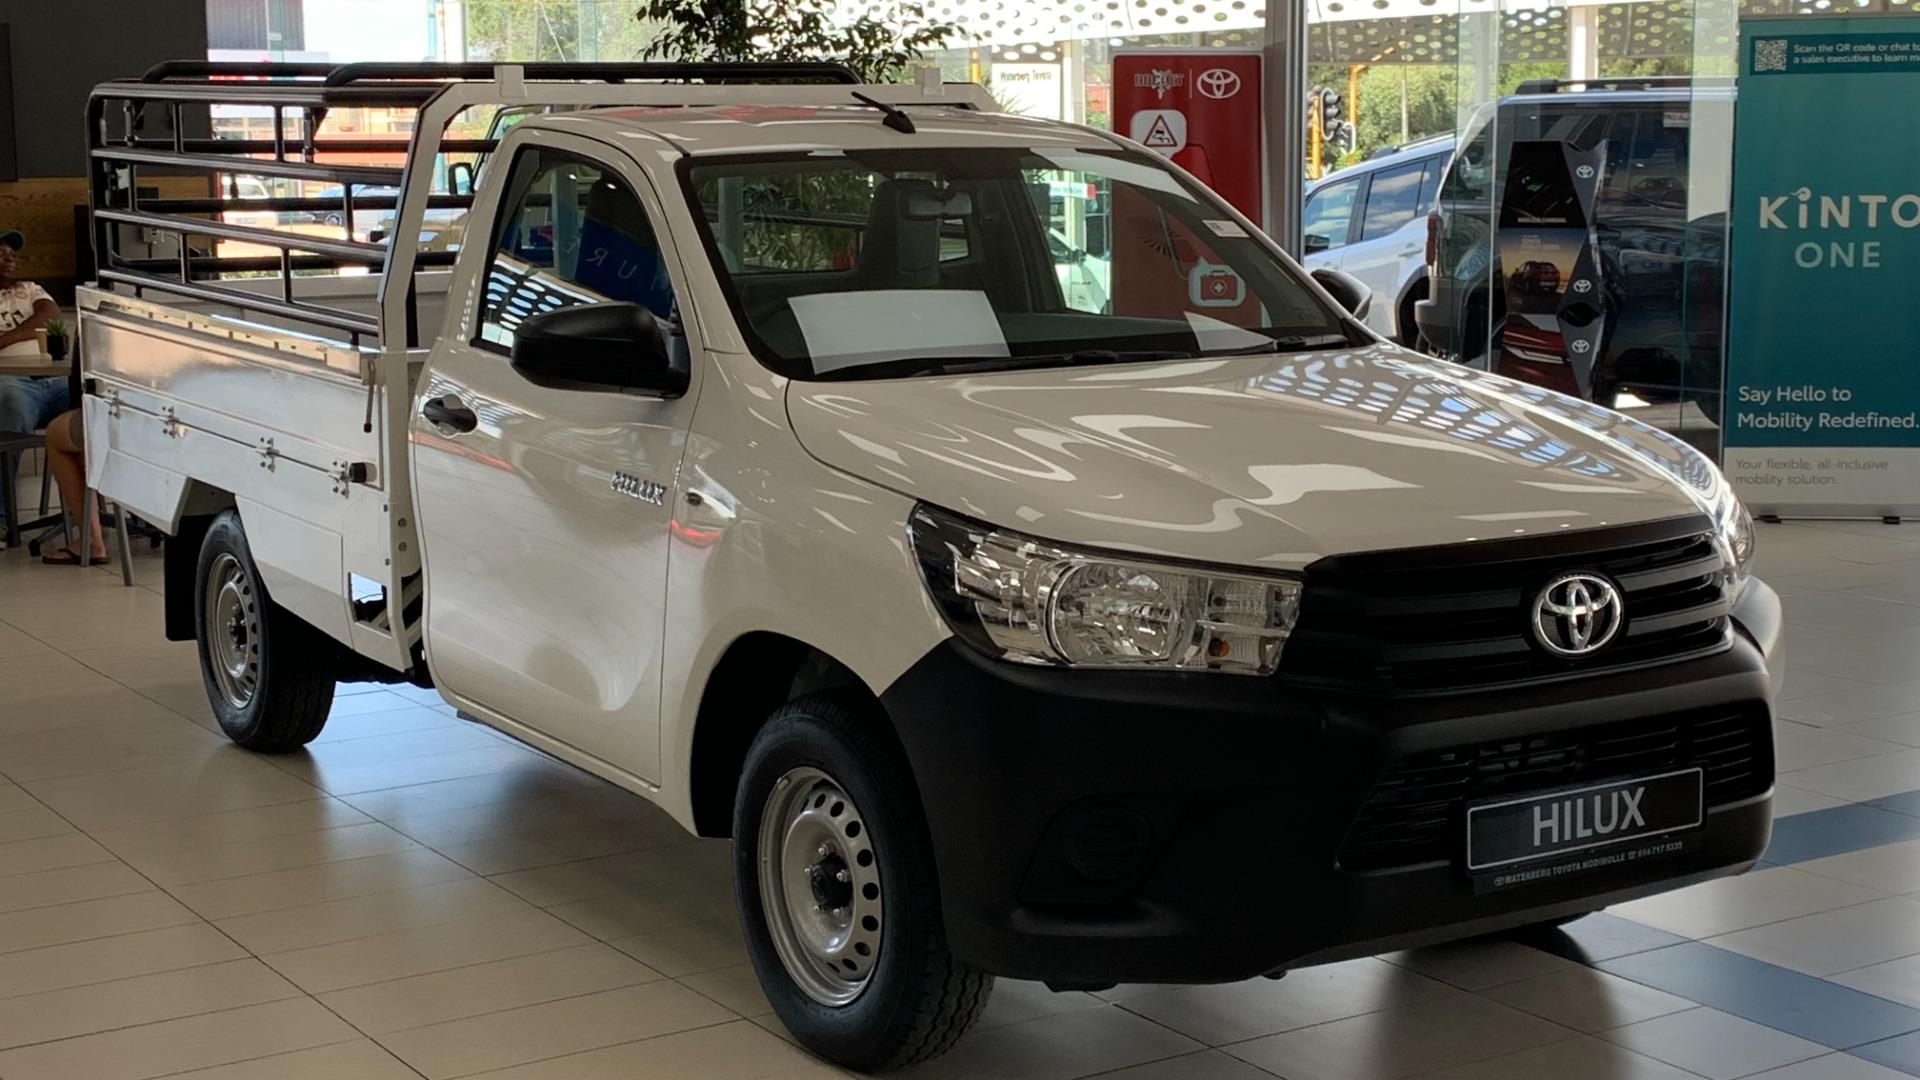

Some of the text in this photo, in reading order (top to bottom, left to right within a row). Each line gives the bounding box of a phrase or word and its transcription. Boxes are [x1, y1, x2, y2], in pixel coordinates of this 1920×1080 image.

[1793, 44, 1816, 53] Scan
[1818, 44, 1834, 53] the
[1836, 43, 1851, 52] QR
[1852, 43, 1876, 52] code
[1890, 43, 1911, 51] chat
[1802, 55, 1825, 63] sales
[1827, 54, 1870, 62] executive
[1872, 54, 1882, 62] to
[1884, 53, 1908, 61] learn
[1795, 241, 1880, 268] ONE
[1739, 385, 1851, 405] Say Hello to
[1737, 412, 1920, 431] Mobility Redefined.
[1736, 460, 1762, 470] Your
[1817, 458, 1888, 470] all-inclusive
[610, 471, 667, 506] HILUX
[1735, 474, 1784, 487] mobility
[1533, 787, 1646, 847] HILUX
[1552, 864, 1581, 876] TOYOTA
